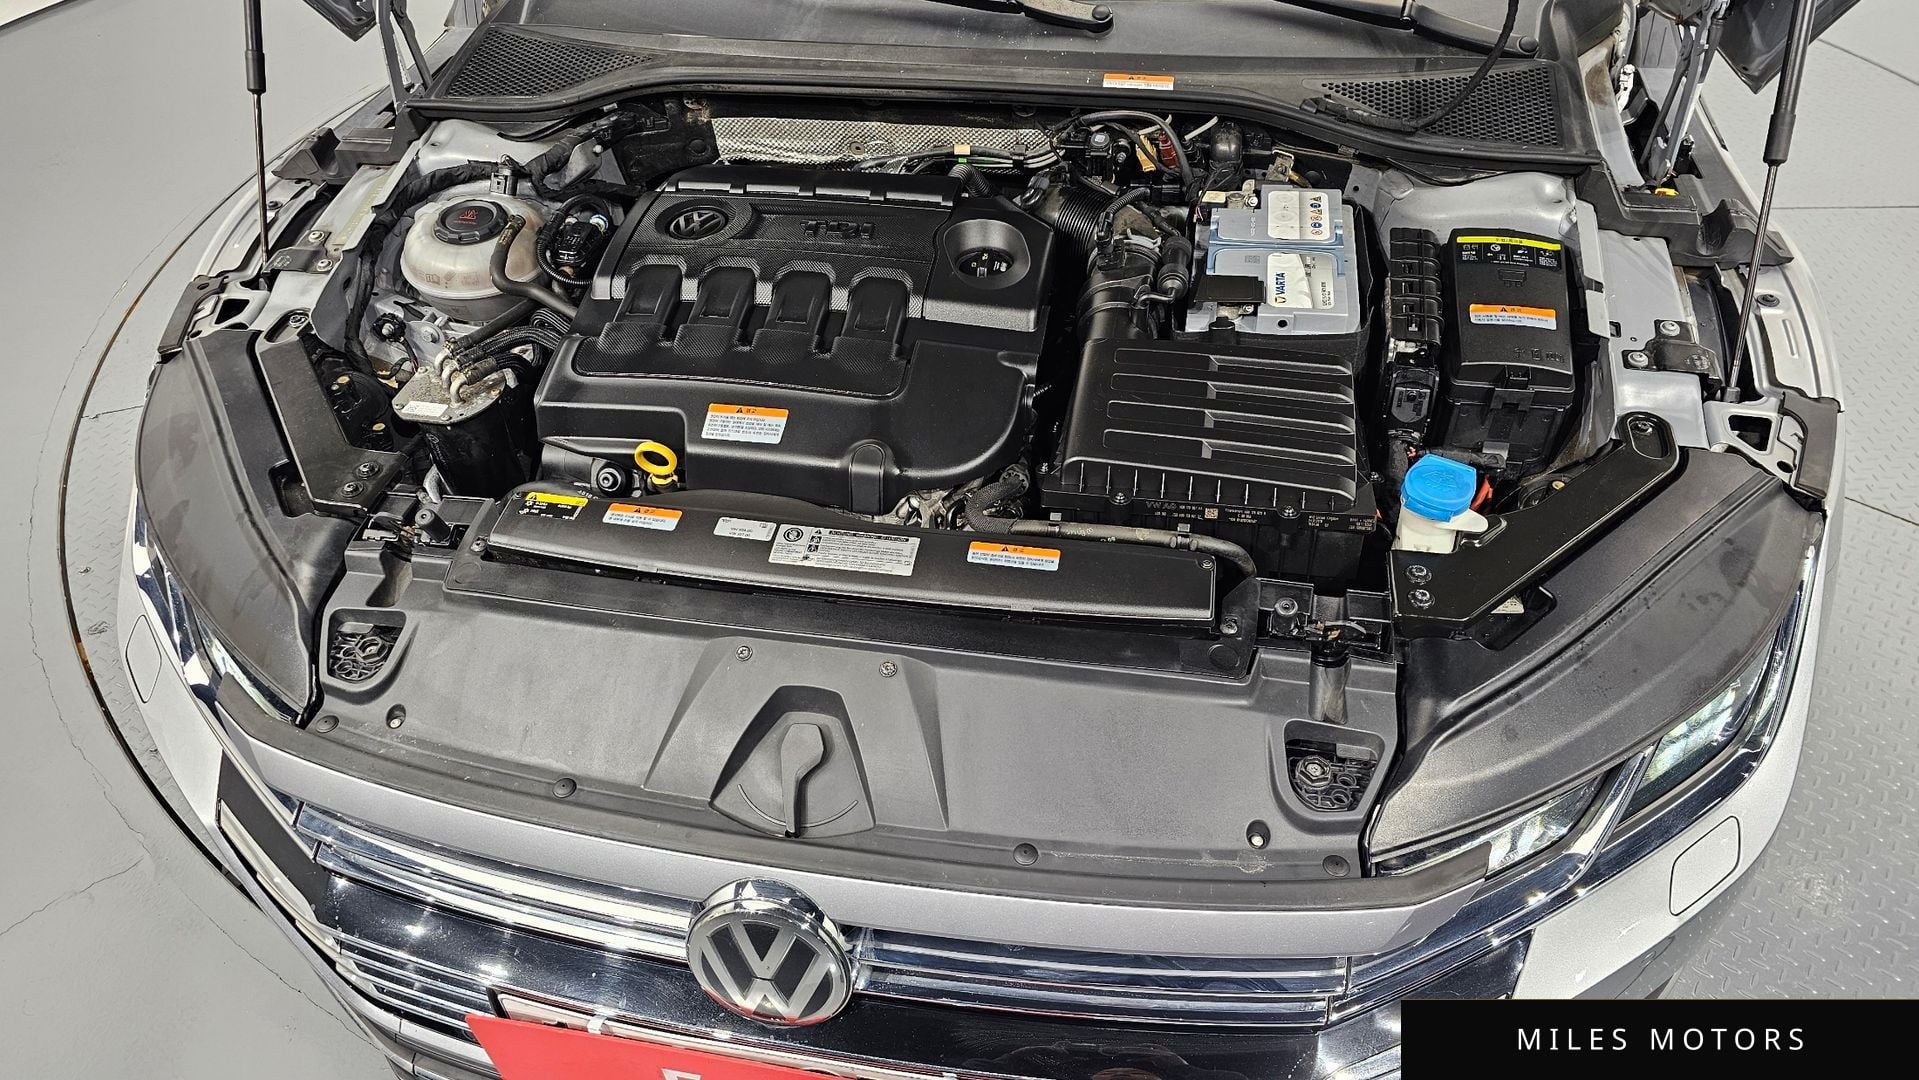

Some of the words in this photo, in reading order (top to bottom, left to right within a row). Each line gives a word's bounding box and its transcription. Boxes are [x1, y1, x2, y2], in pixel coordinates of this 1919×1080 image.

[800, 219, 873, 239] TDI
[1275, 272, 1286, 295] VARTA
[687, 902, 848, 1026] VW
